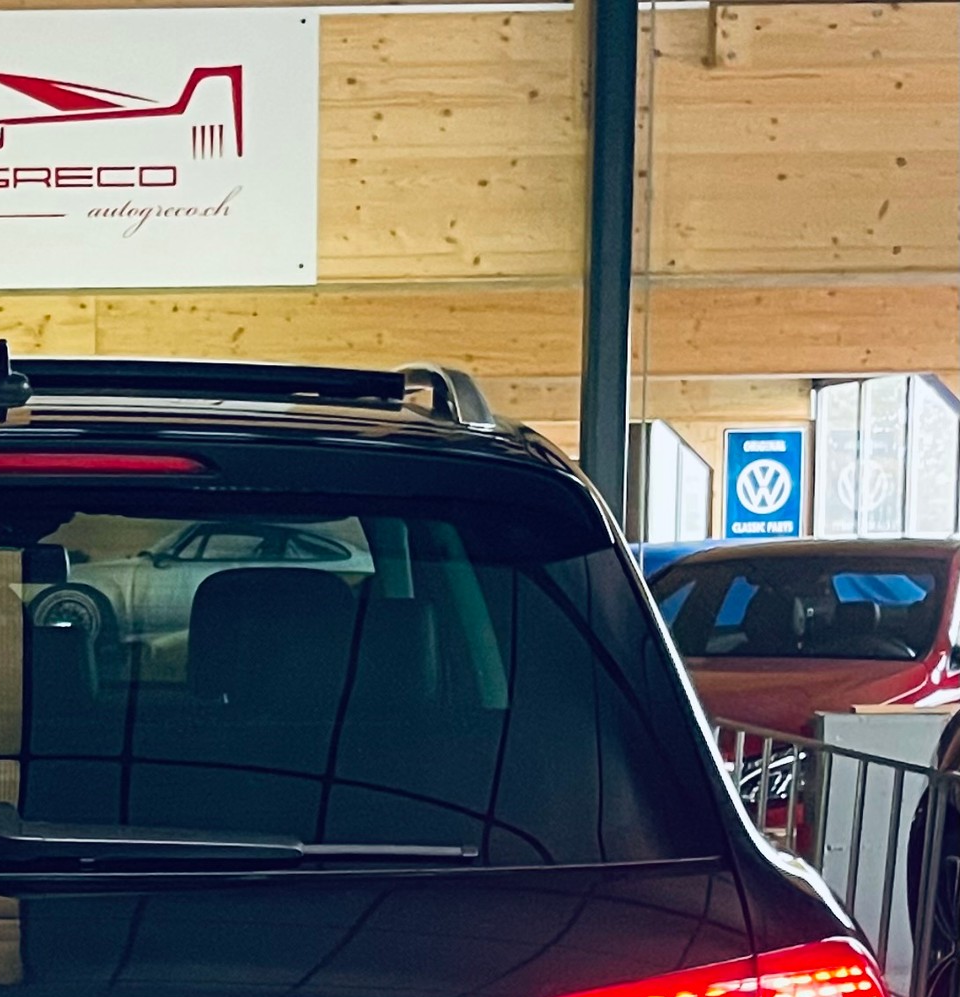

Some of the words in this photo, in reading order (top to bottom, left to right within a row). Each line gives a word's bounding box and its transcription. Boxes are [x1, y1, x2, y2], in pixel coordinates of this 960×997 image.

[87, 186, 243, 239] autogreco.ch
[737, 459, 791, 514] VW
[732, 521, 766, 534] CLASSIC
[767, 520, 794, 533] PARTS
